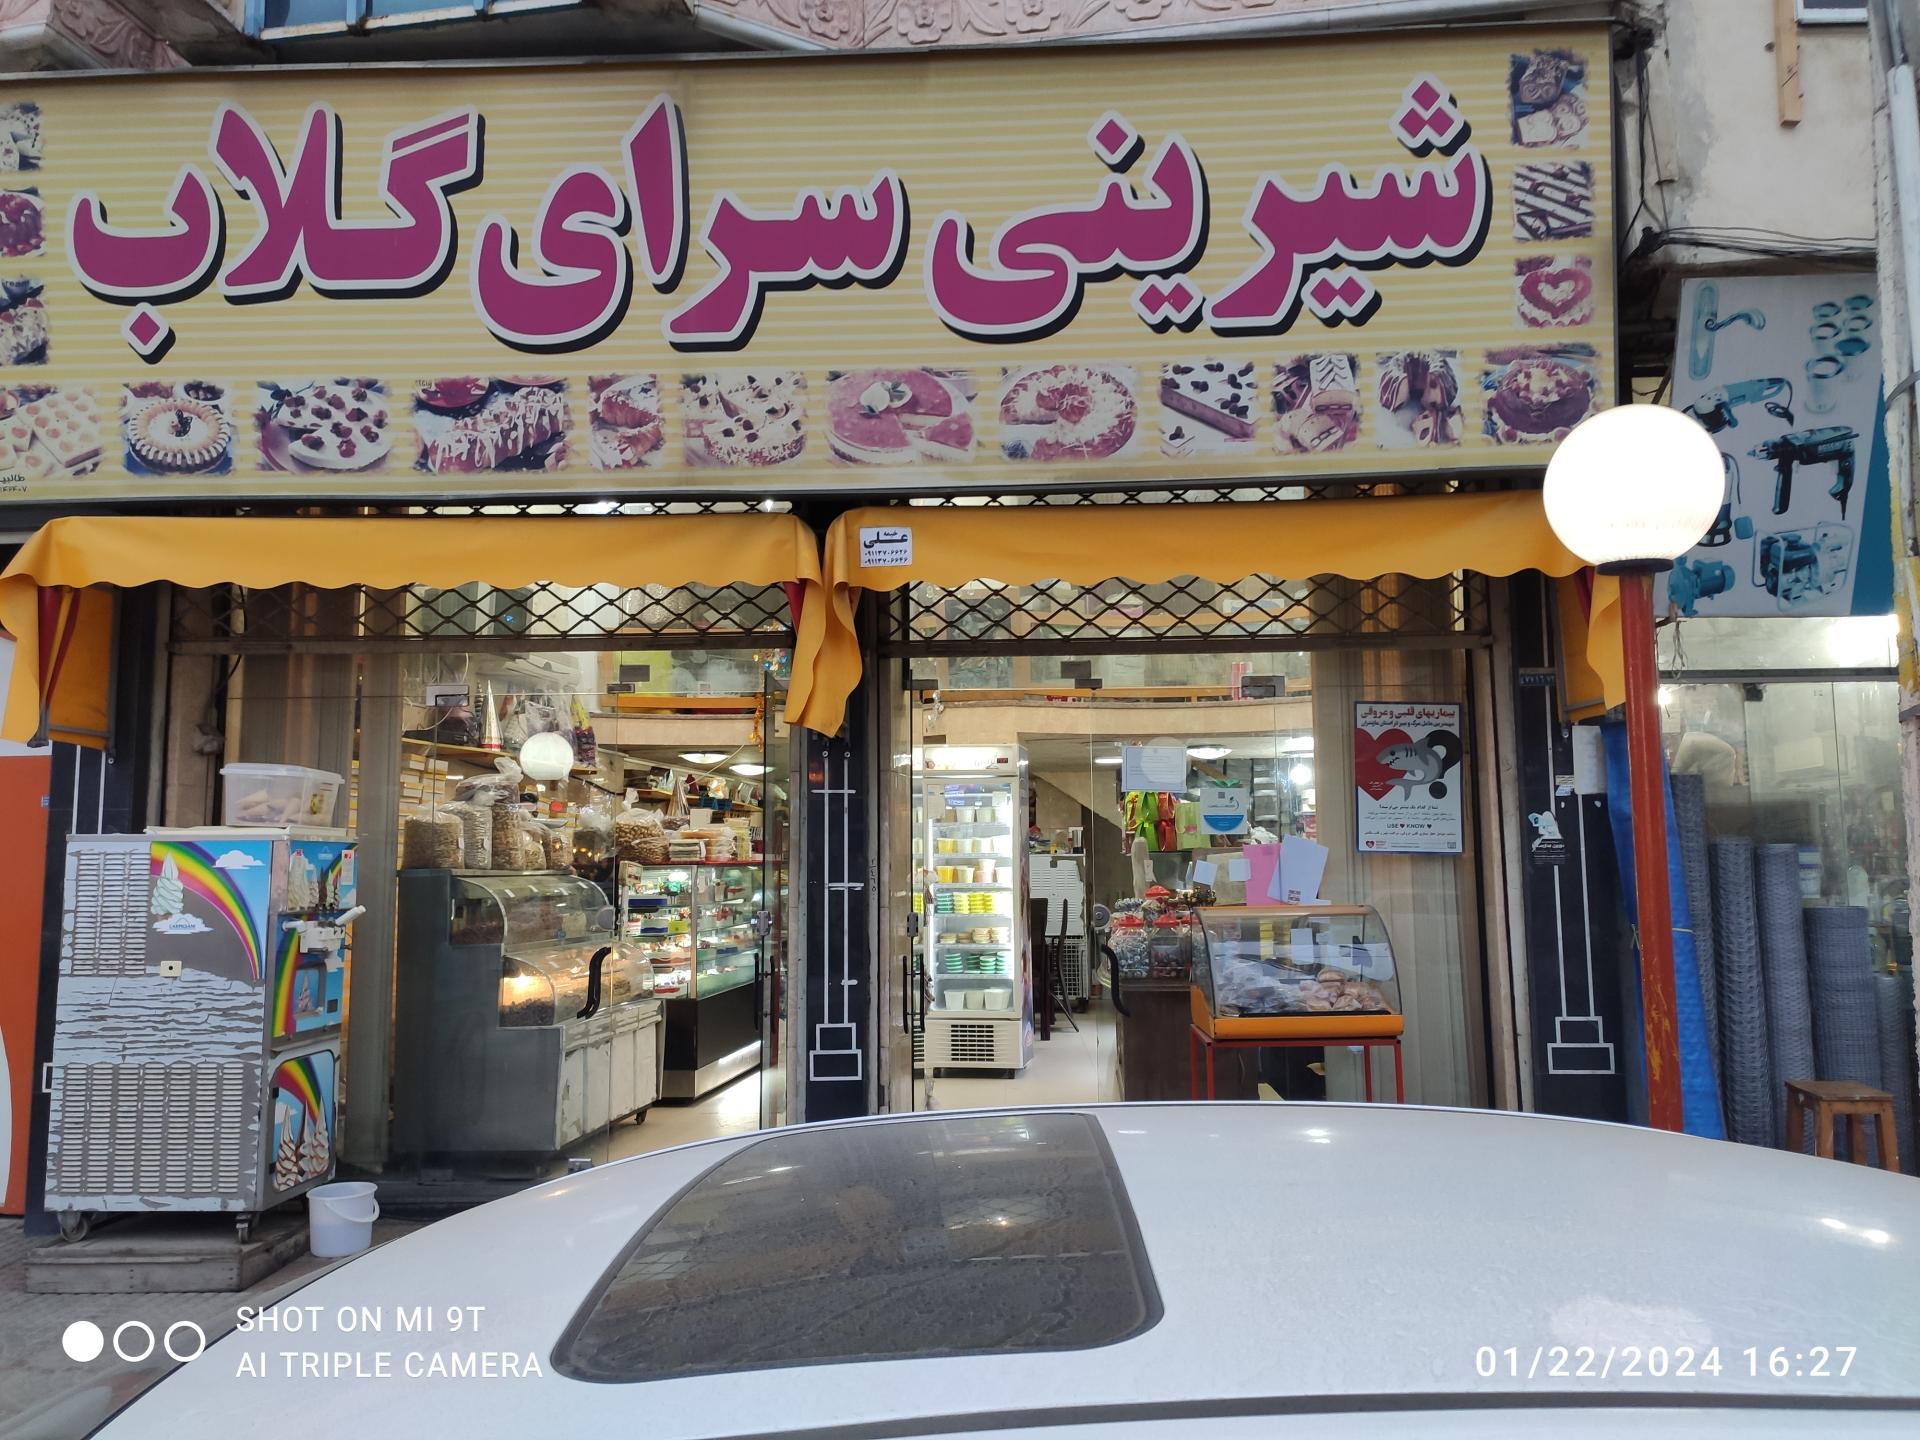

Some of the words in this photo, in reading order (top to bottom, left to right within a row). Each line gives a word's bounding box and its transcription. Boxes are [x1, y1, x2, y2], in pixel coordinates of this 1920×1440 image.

[67, 100, 484, 364] گلاب
[470, 94, 909, 353] سرای
[925, 74, 1490, 342] شیرینی
[864, 531, 908, 549] علی
